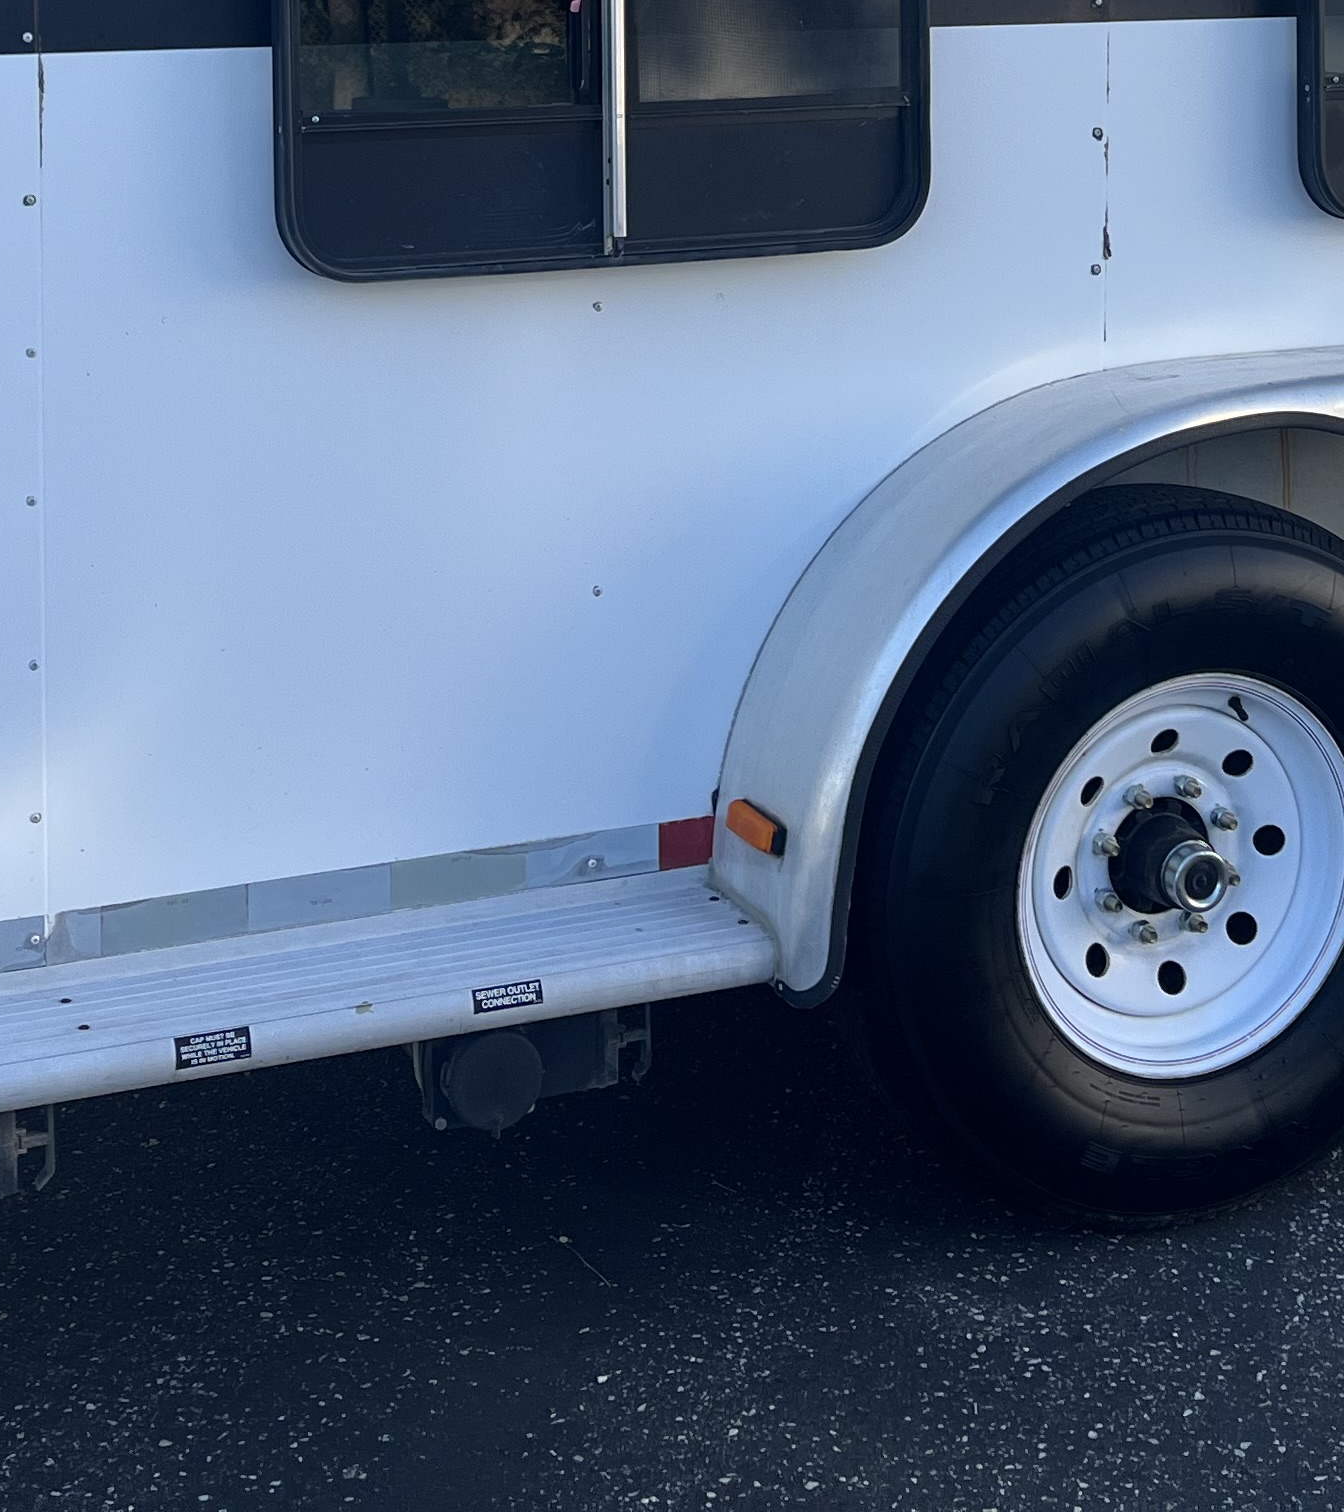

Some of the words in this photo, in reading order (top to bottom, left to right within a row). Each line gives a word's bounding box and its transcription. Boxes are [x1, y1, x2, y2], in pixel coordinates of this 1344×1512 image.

[475, 988, 506, 1000] SEWER
[507, 982, 540, 995] OUTLET
[481, 992, 537, 1009] CONNECTION
[180, 1041, 216, 1053] SECURELY
[225, 1036, 247, 1046] PLACE
[189, 1036, 204, 1044] CAP
[205, 1033, 224, 1042] MUST
[181, 1051, 203, 1061] WHILE
[204, 1048, 217, 1056] THE
[219, 1044, 247, 1054] VEHICLE
